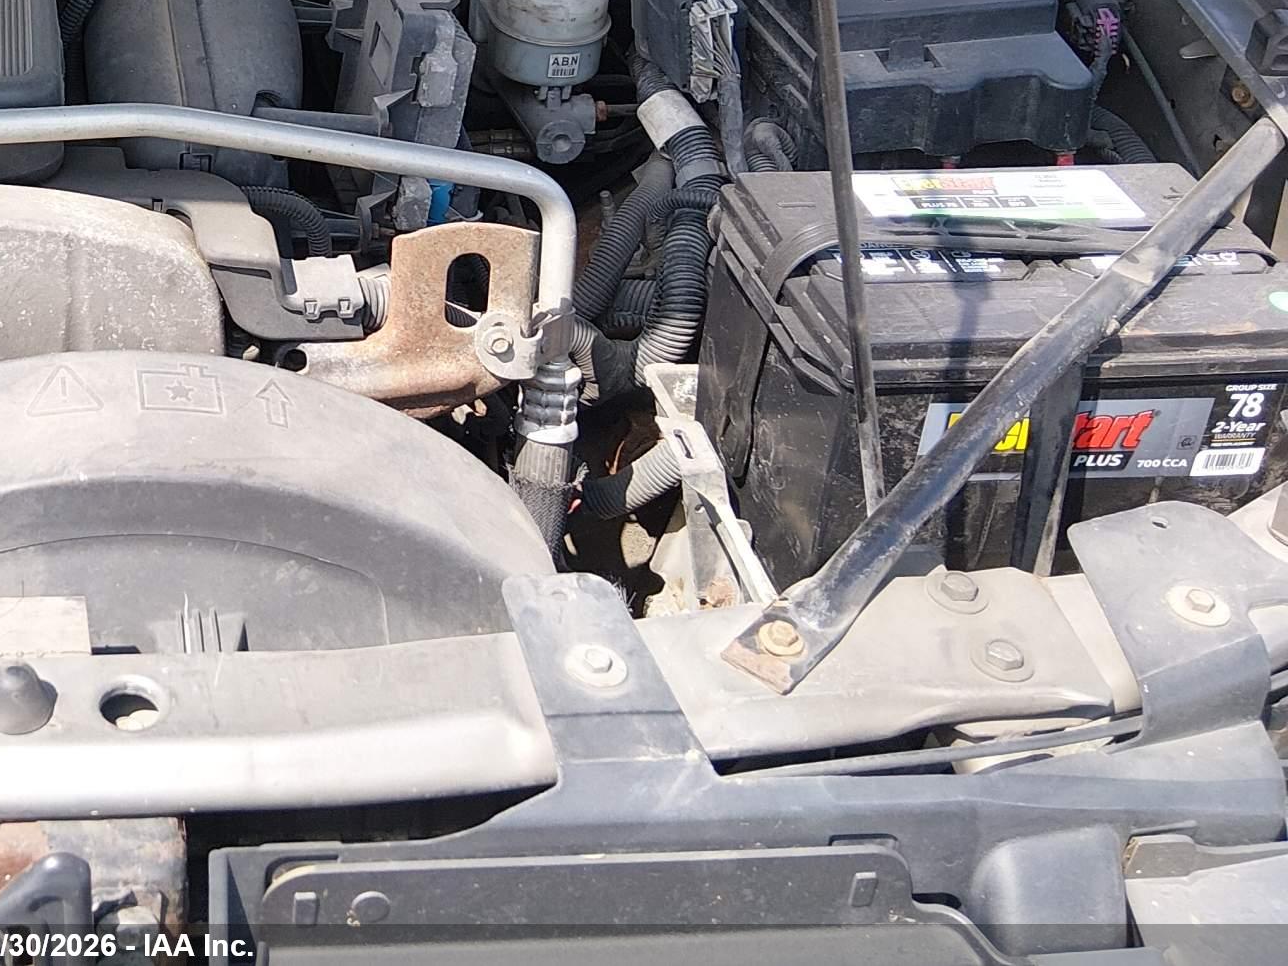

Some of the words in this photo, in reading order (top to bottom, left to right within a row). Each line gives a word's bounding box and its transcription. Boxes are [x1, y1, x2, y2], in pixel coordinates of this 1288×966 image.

[552, 56, 578, 66] ABN
[1228, 392, 1264, 418] 78
[1211, 421, 1266, 433] 2-Year
[1214, 432, 1257, 440] WARRANTY
[1073, 453, 1123, 467] PLUS
[1137, 459, 1161, 468] 700
[1162, 458, 1188, 468] CCA
